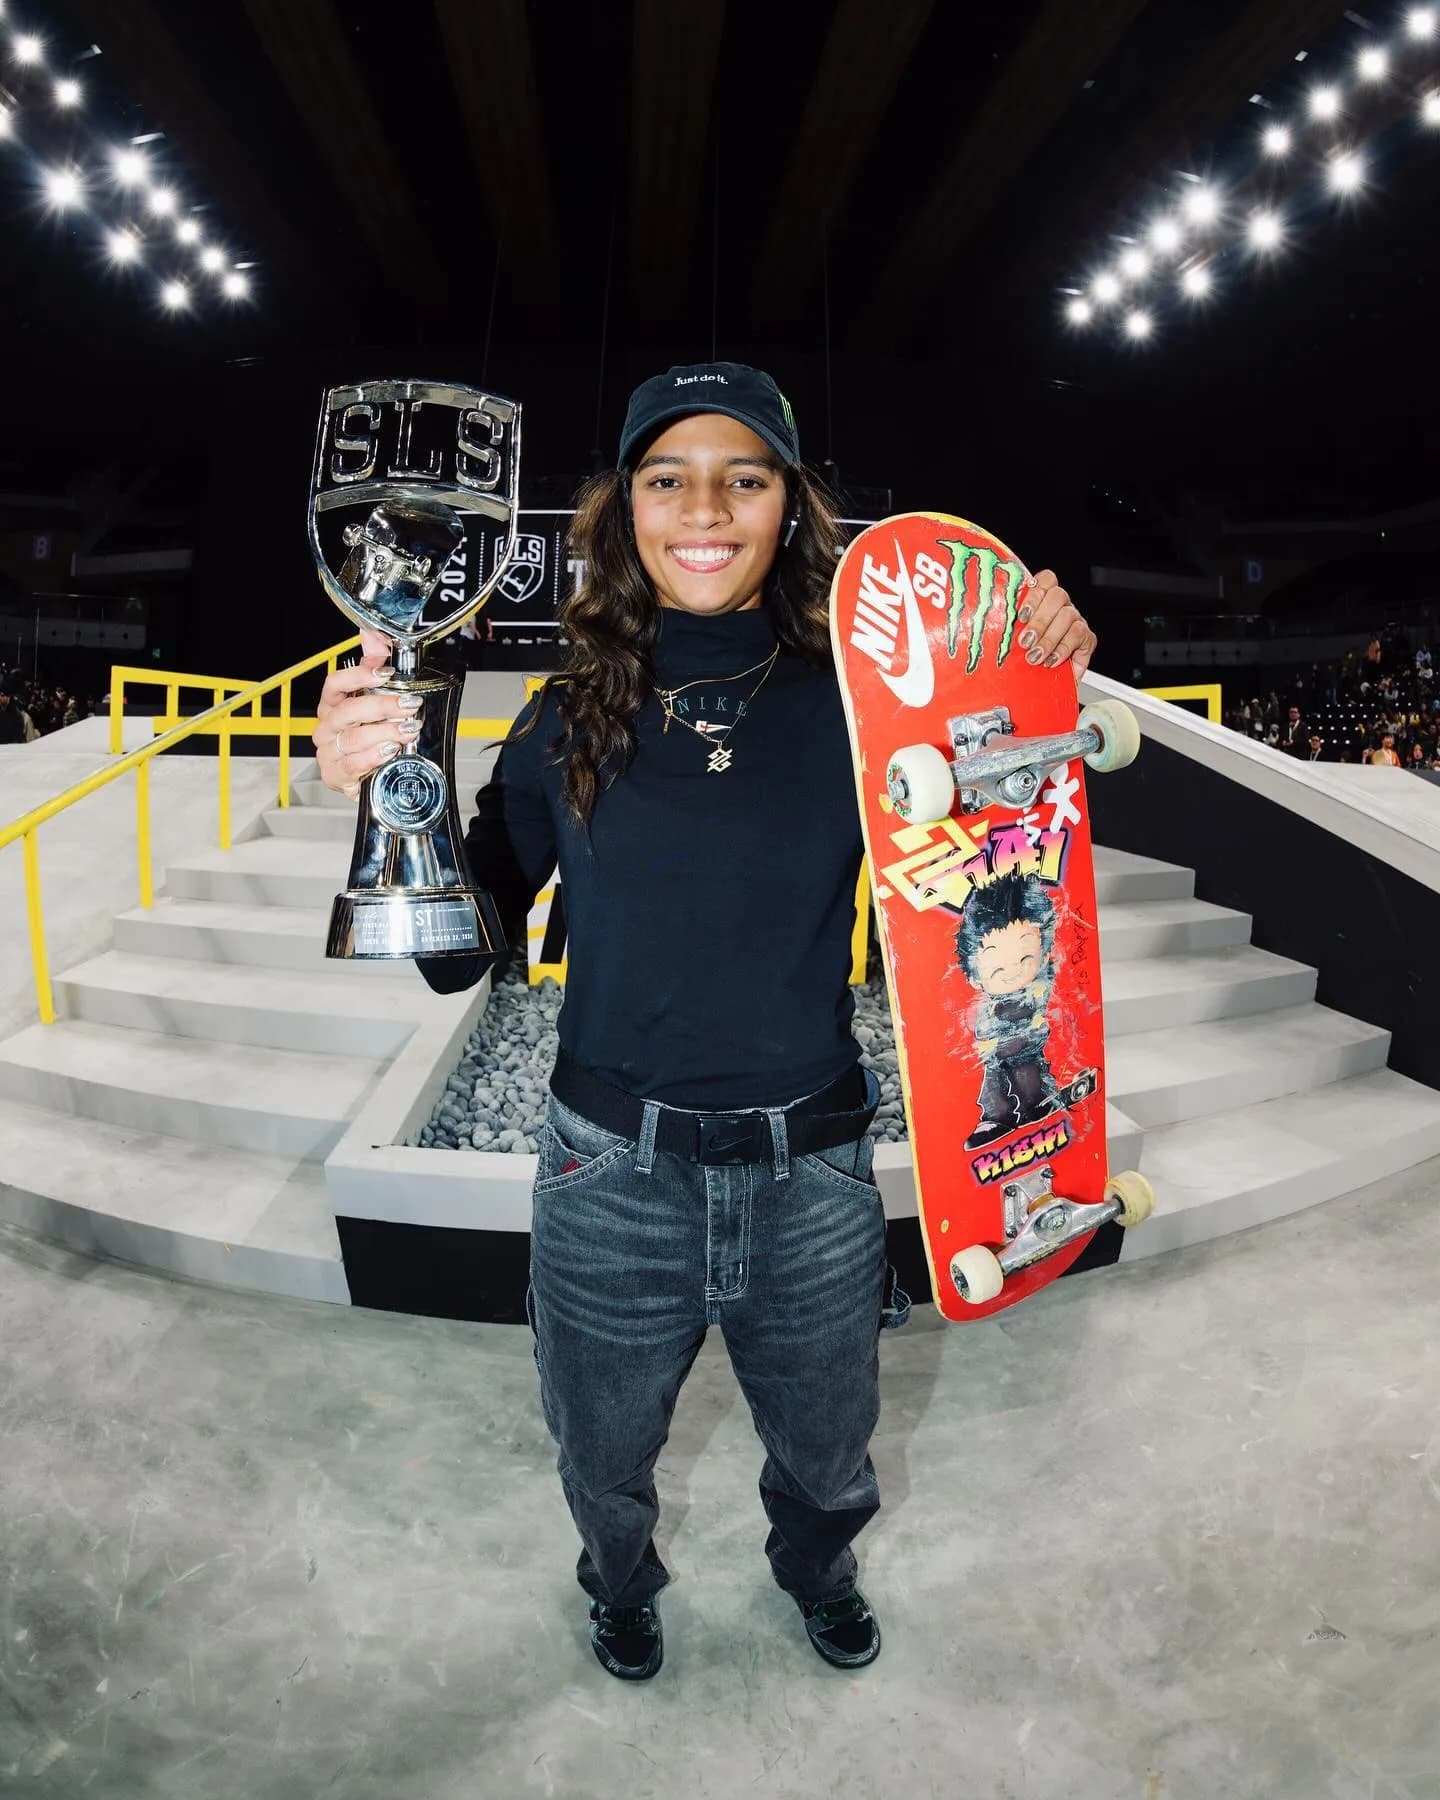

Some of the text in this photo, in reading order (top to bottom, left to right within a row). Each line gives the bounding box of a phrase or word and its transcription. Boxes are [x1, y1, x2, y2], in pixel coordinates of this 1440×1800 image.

[674, 374, 729, 387] Just do it.
[331, 399, 504, 491] SLS
[912, 552, 949, 609] SB
[849, 552, 905, 672] NIKE
[676, 696, 748, 717] NIKE
